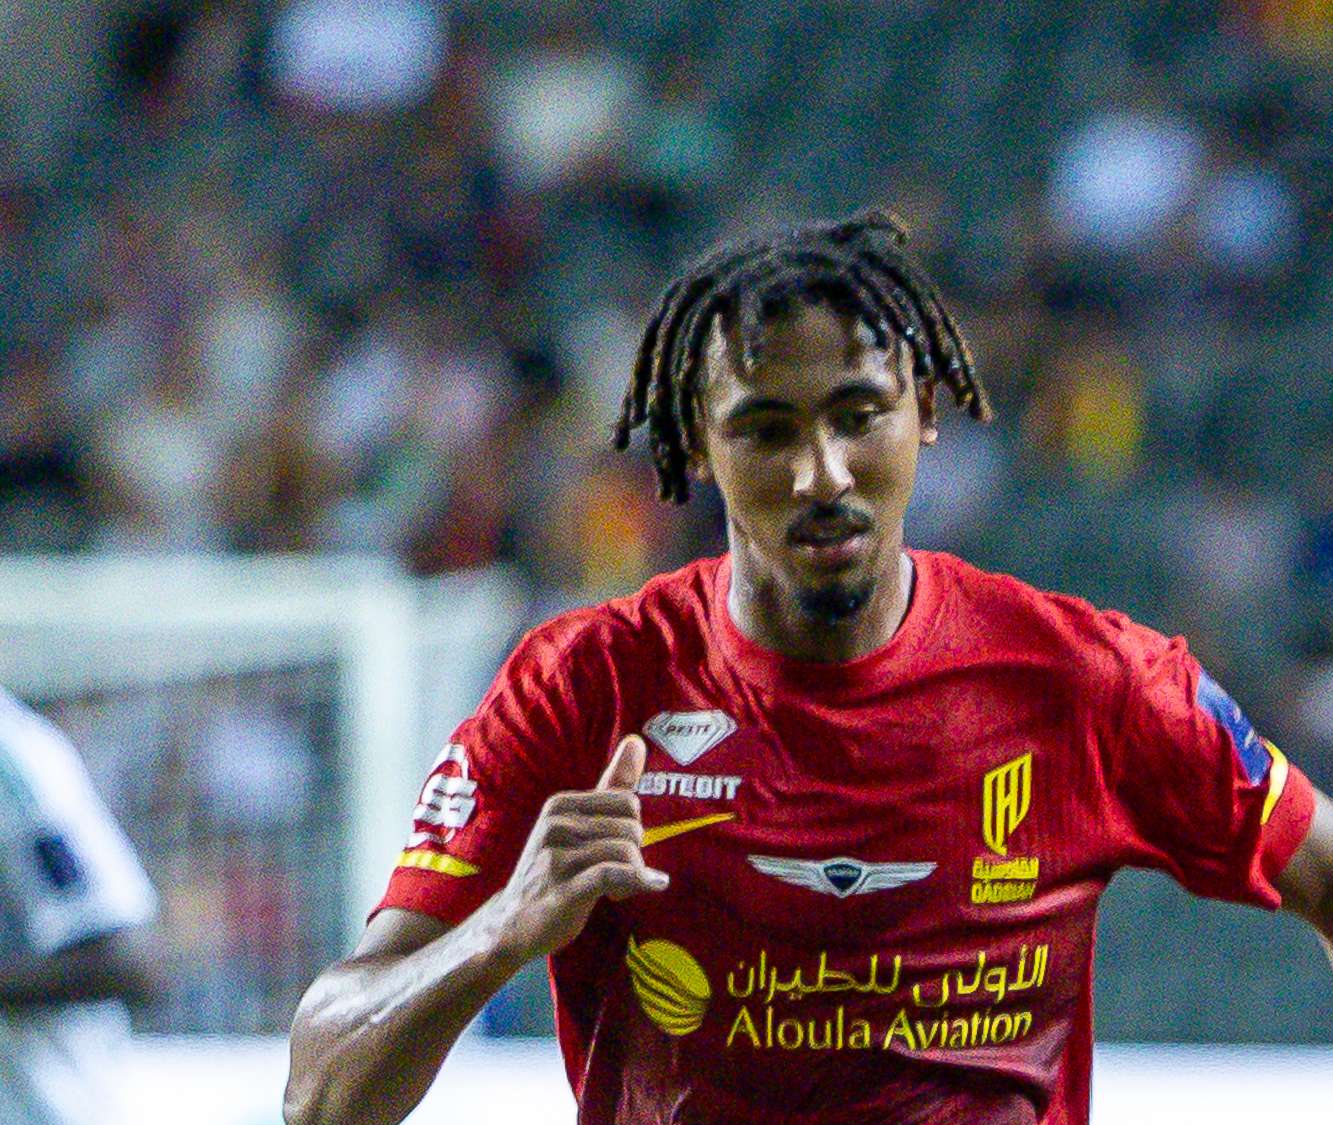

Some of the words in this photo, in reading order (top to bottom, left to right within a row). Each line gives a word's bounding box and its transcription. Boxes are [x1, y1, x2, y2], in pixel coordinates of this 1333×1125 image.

[726, 950, 902, 1004] للطيران
[726, 1004, 872, 1051] Aloula
[882, 1007, 1033, 1051] Aviation
